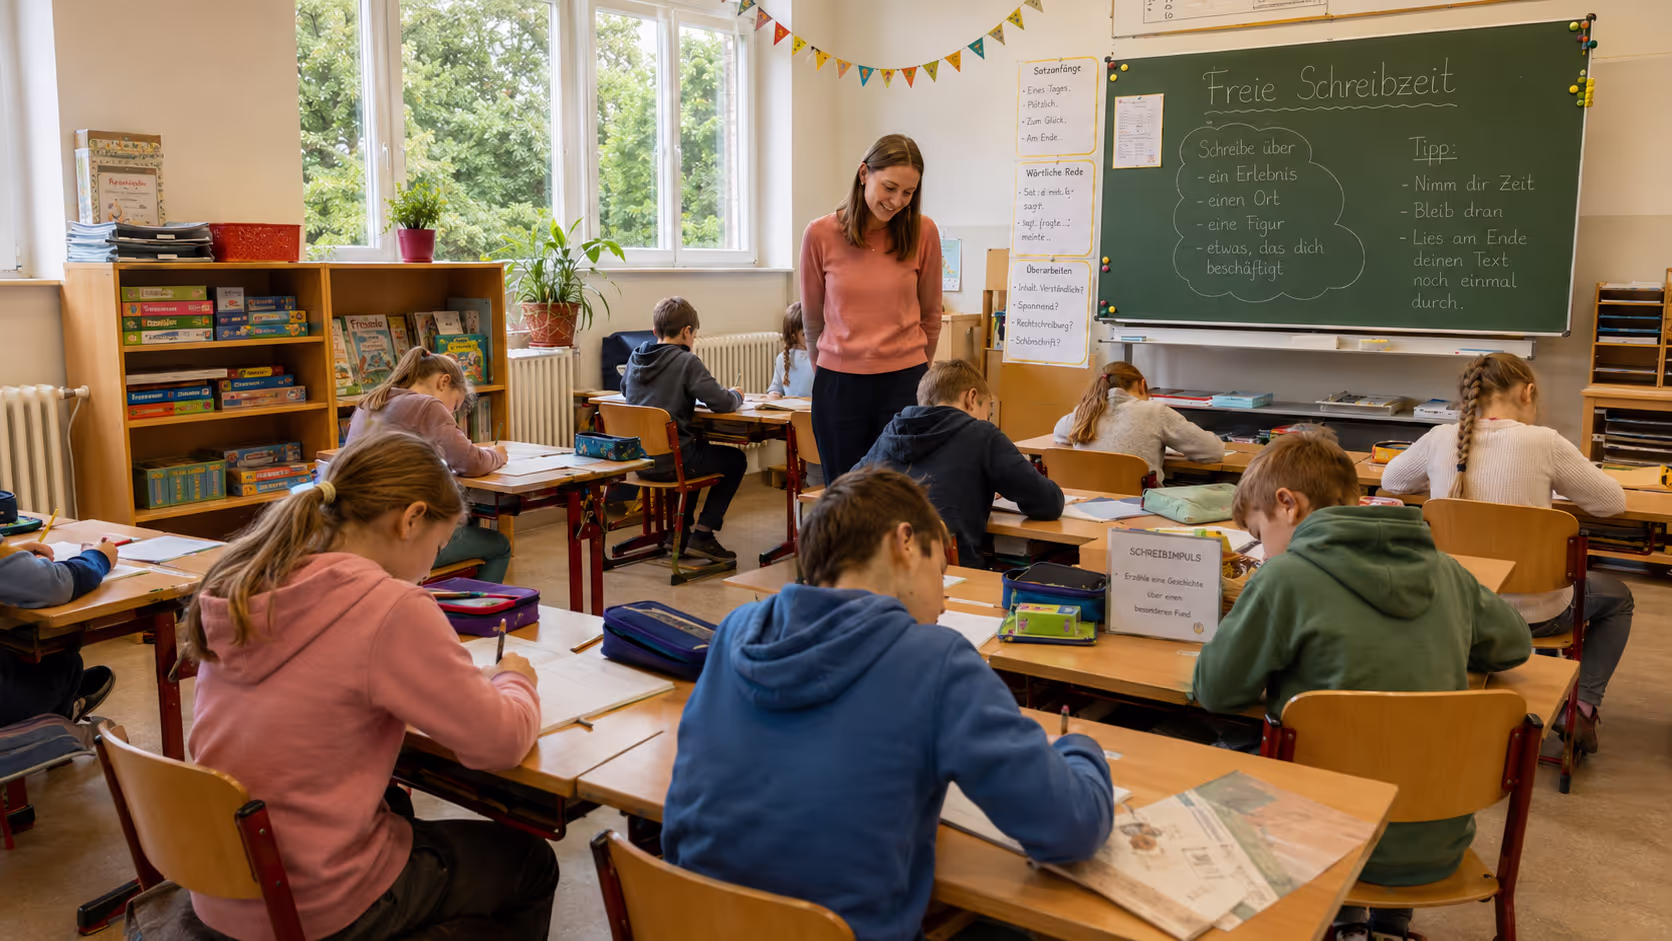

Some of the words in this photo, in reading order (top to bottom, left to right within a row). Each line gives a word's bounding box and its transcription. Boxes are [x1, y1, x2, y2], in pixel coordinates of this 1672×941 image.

[1033, 64, 1082, 75] Satzanfänge
[1202, 66, 1277, 105] Freie
[1296, 57, 1457, 100] Schreibzeit
[1026, 134, 1039, 142] Am
[1198, 138, 1256, 158] Schreibe
[1262, 136, 1296, 155] über
[1408, 136, 1456, 167] Tipp:
[1026, 168, 1062, 177] Wörtliche
[1065, 167, 1084, 176] Rede
[1208, 169, 1229, 184] ein
[1236, 163, 1298, 182] Erlebnis
[1414, 174, 1457, 192] Nimm
[1466, 174, 1490, 192] dir
[1499, 173, 1535, 191] Zeit
[1208, 193, 1246, 207] einen
[1253, 189, 1281, 206] Ort
[1413, 201, 1454, 219] Bleib
[1464, 201, 1504, 218] dran
[1208, 217, 1237, 231] eine
[1246, 214, 1285, 237] Figur
[1413, 228, 1444, 245] Lies
[1452, 233, 1477, 245] am
[1486, 228, 1527, 245] Ende
[1207, 239, 1252, 256] etwas,
[1259, 239, 1286, 255] das
[1293, 238, 1325, 254] dich
[1413, 250, 1463, 267] deinen
[1472, 251, 1509, 268] Text
[1026, 264, 1073, 275] Überarbeiten
[1206, 259, 1284, 282] beschäftigt
[1413, 271, 1449, 287] noch
[1460, 271, 1518, 288] einmal
[1411, 292, 1464, 310] durch.
[1129, 547, 1202, 563] SCHREIBIMPULS
[1124, 572, 1150, 582] Erzähle
[1167, 577, 1204, 588] Geschichte
[1134, 604, 1173, 616] besonderen
[1174, 609, 1192, 618] Fund
